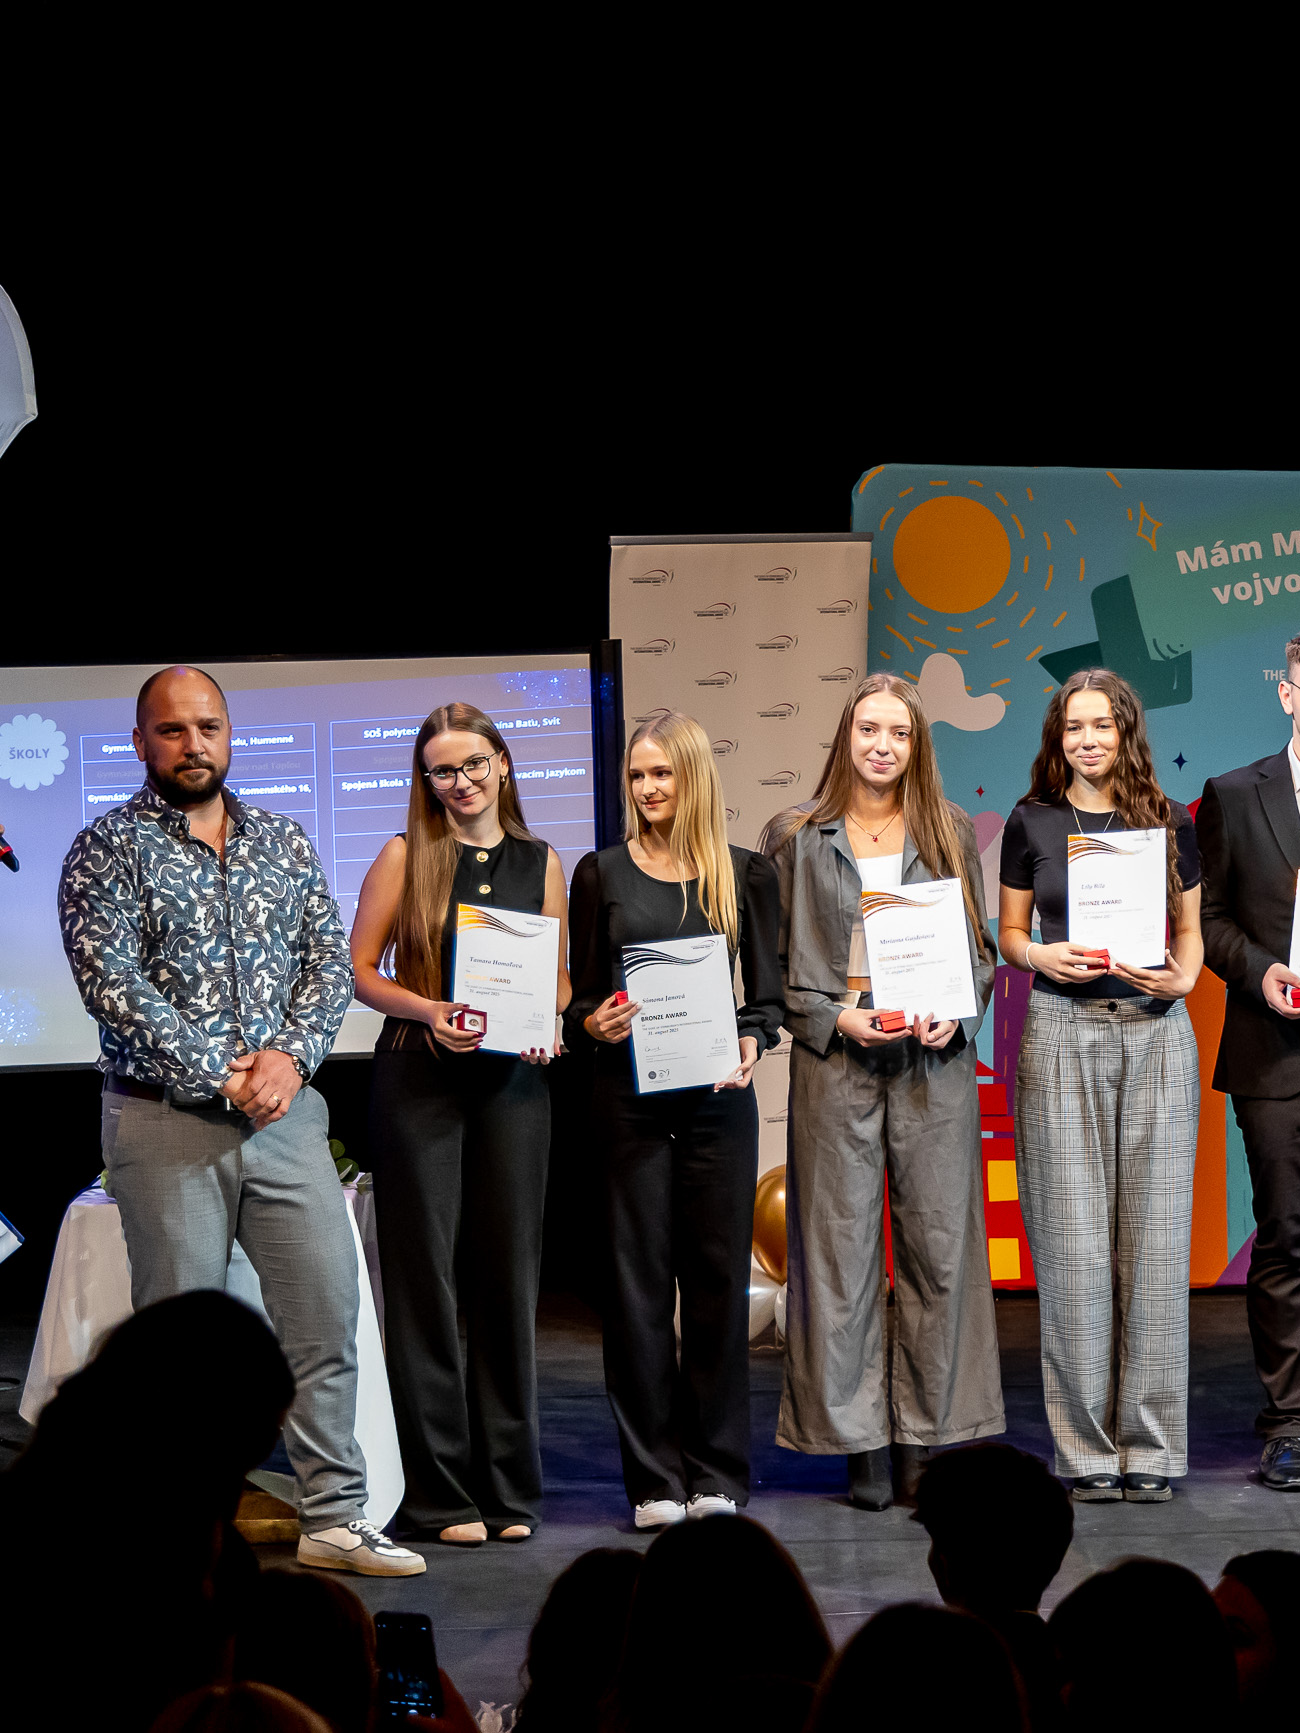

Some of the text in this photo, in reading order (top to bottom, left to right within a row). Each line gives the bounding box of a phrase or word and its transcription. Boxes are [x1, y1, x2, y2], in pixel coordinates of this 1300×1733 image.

[1176, 539, 1262, 574] Mám
[1263, 669, 1286, 680] THE
[364, 728, 381, 738] SOŠ
[383, 726, 420, 739] polytech
[102, 743, 136, 754] Gymnáz
[250, 734, 294, 745] Humenné
[9, 746, 50, 760] ŠKOLY
[342, 780, 378, 792] Spojená
[379, 778, 404, 788] škola
[545, 768, 586, 780] jazykom
[87, 784, 312, 804] Gymnáziu Komenského 16,
[640, 1011, 688, 1022] BRONZE AWARD
